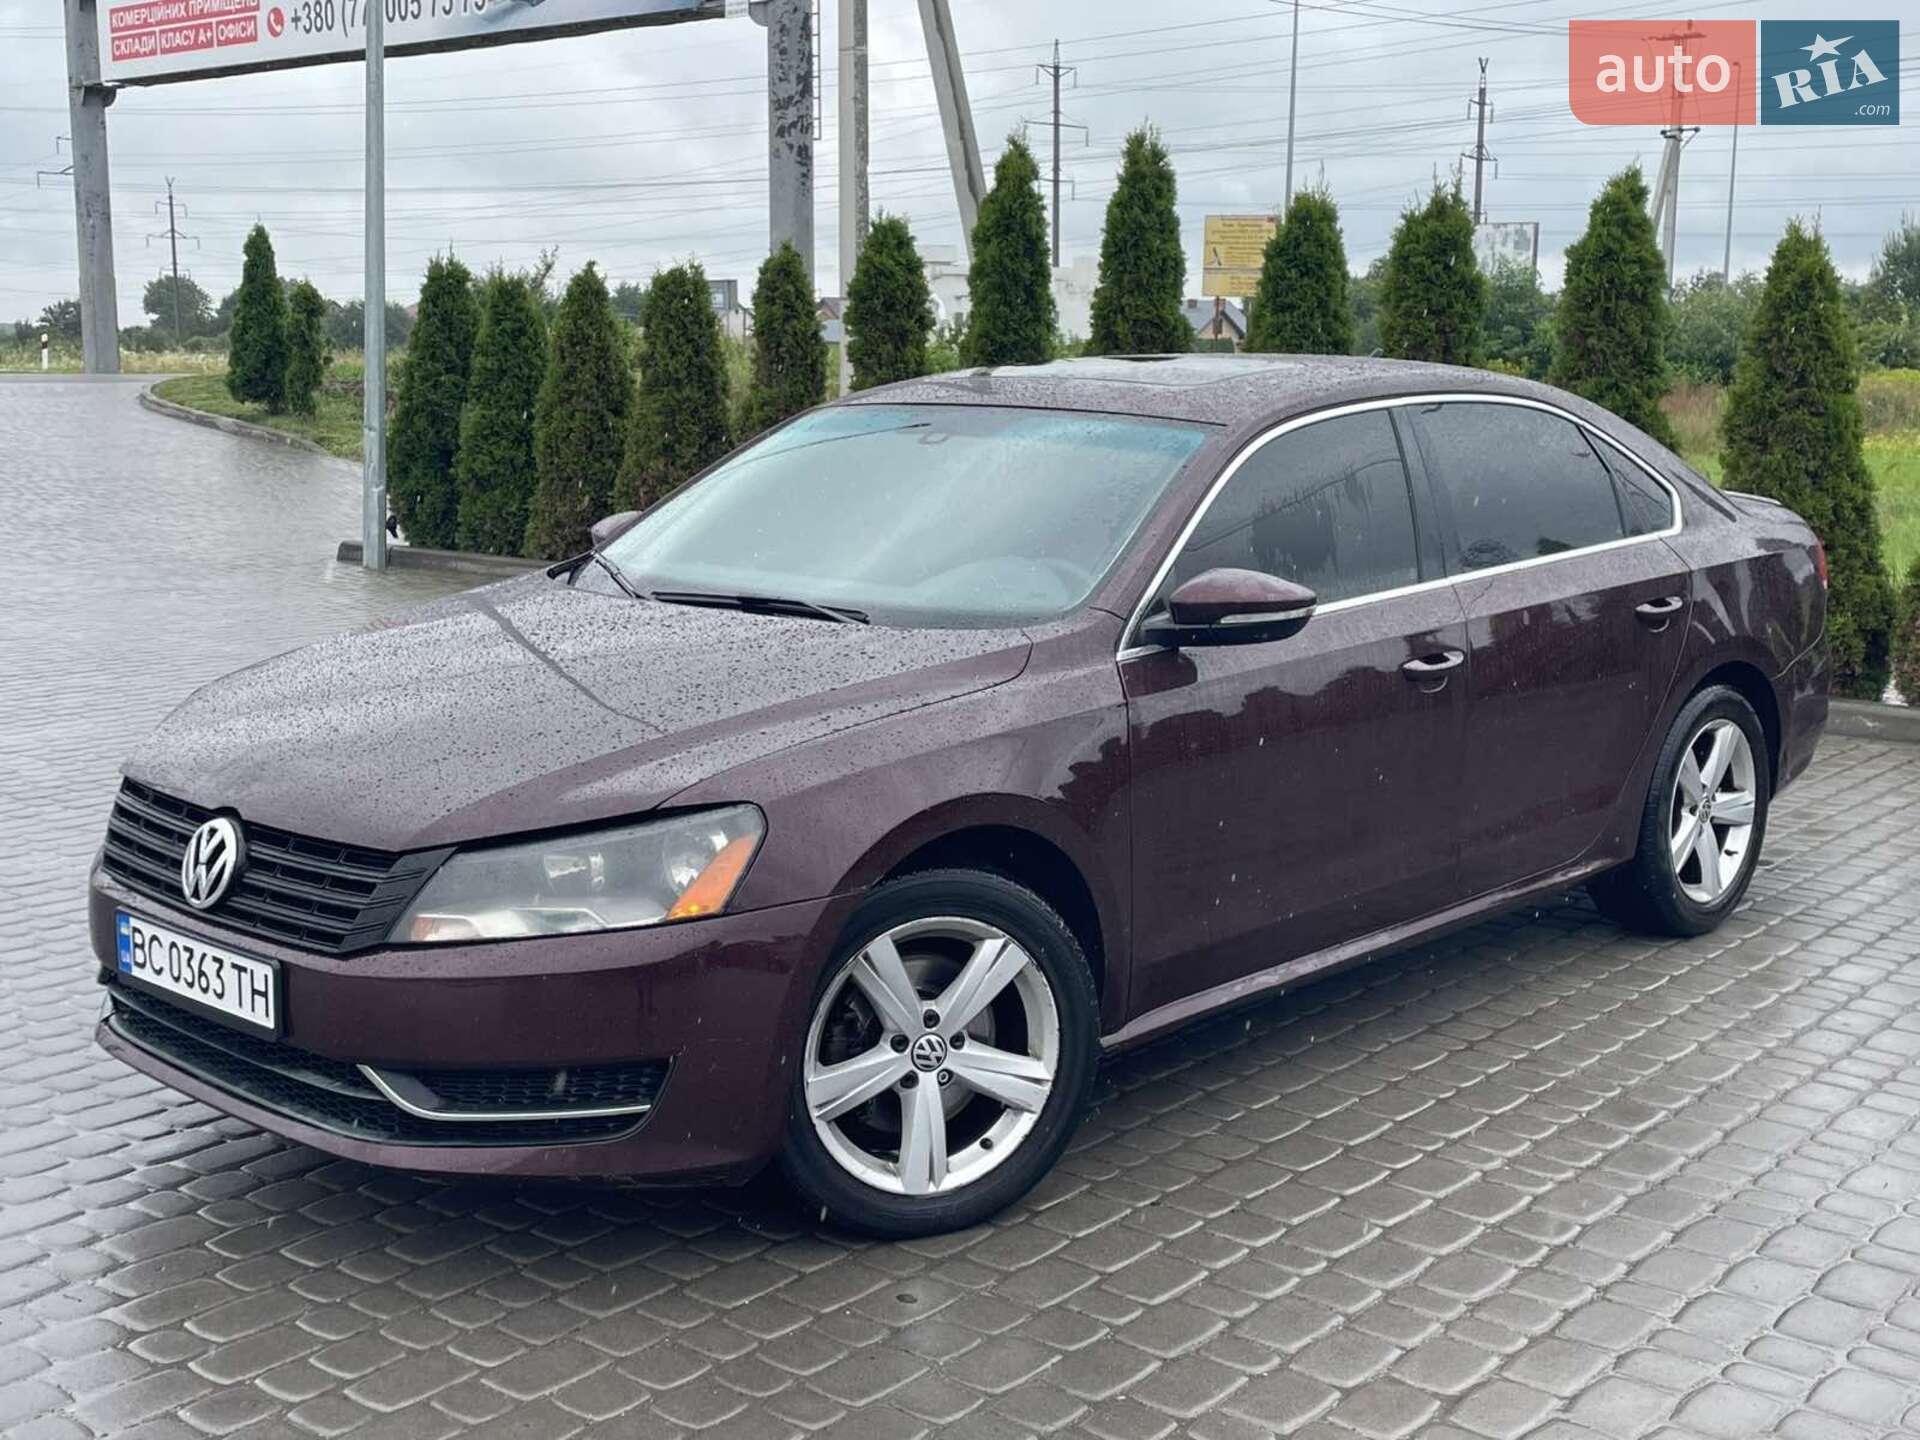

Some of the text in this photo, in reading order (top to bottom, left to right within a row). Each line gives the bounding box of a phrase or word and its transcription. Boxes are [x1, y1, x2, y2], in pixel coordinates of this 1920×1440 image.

[112, 1, 187, 28] КОМЕРЦІЙНИХ
[290, 0, 335, 34] +380
[160, 29, 196, 49] КЛАСУ
[218, 19, 256, 41] ОФІСИ
[113, 35, 156, 56] СКЛАДИ
